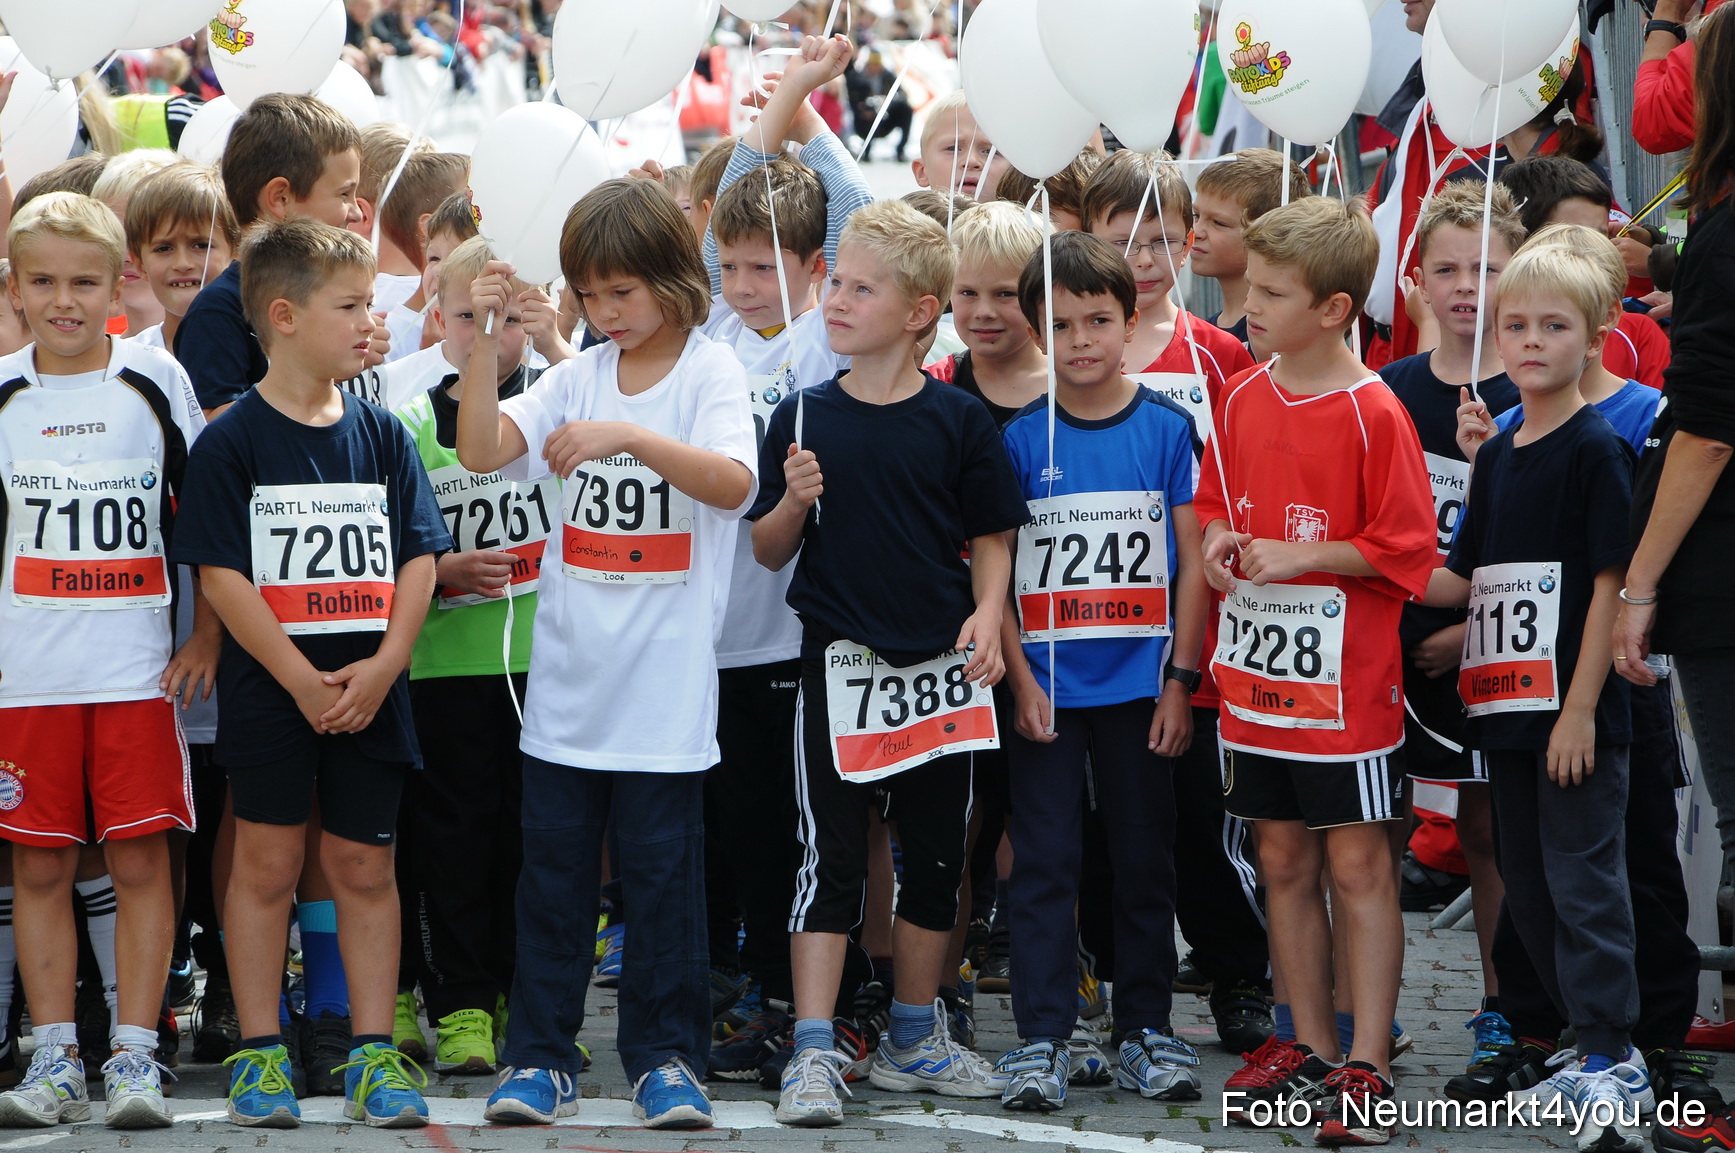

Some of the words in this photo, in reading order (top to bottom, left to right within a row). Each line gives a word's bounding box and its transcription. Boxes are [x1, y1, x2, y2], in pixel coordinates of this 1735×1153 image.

[1284, 79, 1310, 95] steigen
[11, 475, 62, 490] PARTL
[67, 475, 136, 491] Neumarkt
[434, 479, 468, 497] ARTL
[255, 501, 307, 516] PARTL
[312, 500, 377, 514] Neumarkt
[571, 469, 670, 532] 7391
[1296, 508, 1315, 517] TSV
[25, 496, 147, 551] 7108
[441, 483, 551, 554] 7261
[1069, 507, 1143, 523] Neumarkt
[270, 524, 388, 580] 7205
[569, 537, 619, 561] Constantin
[1034, 531, 1152, 589] 7242
[52, 568, 130, 591] Fabian
[602, 573, 625, 581] 2006
[1478, 579, 1532, 598] Neumarkt
[307, 590, 374, 615] Robin
[1060, 598, 1129, 622] Marco
[1465, 599, 1538, 660] 7113
[1226, 611, 1323, 679] 7228
[1251, 683, 1281, 708] tim
[1471, 670, 1517, 698] Vincent
[846, 664, 973, 730] 7388
[878, 733, 914, 757] Paul
